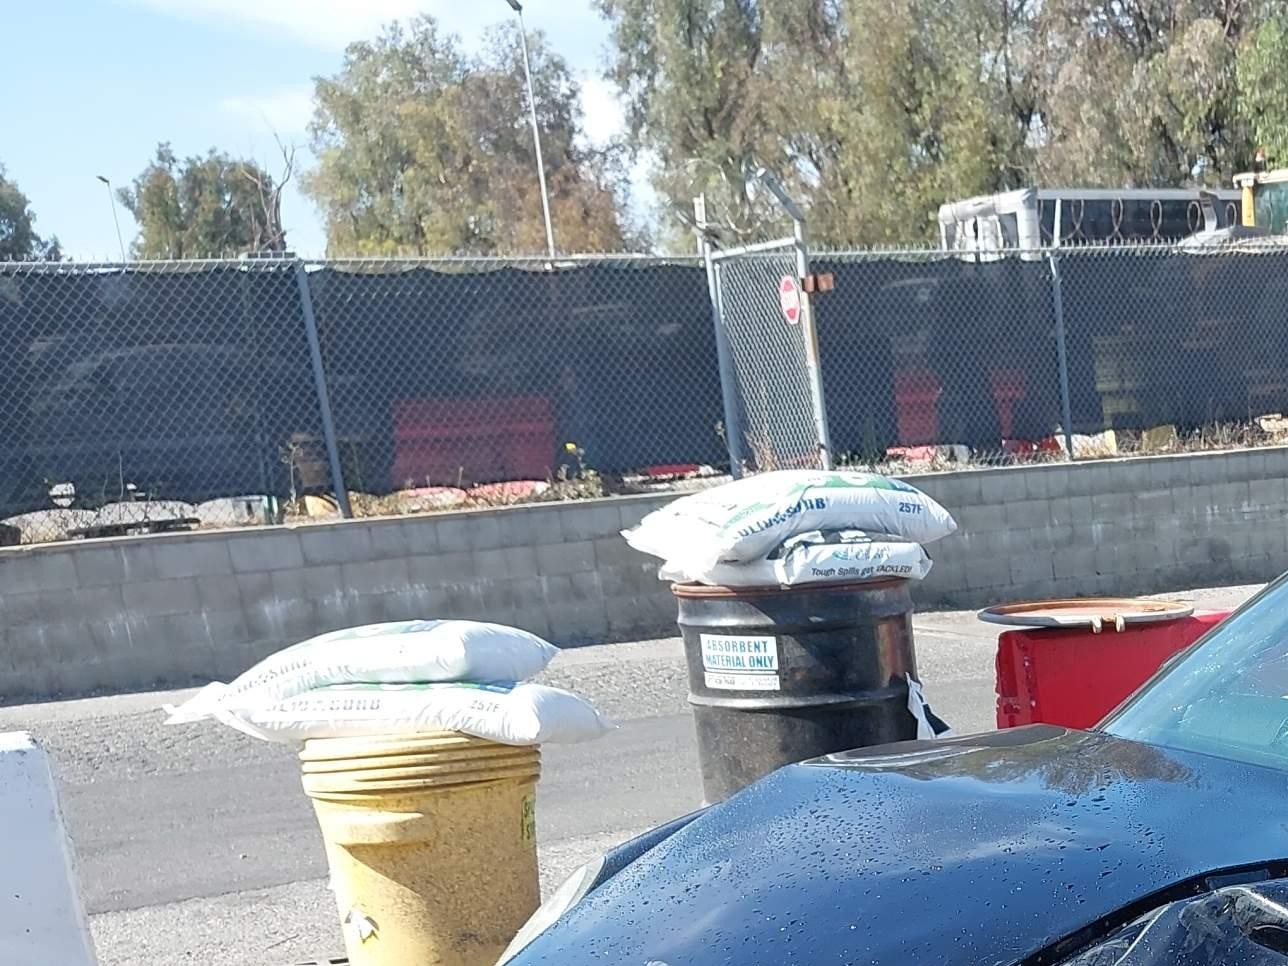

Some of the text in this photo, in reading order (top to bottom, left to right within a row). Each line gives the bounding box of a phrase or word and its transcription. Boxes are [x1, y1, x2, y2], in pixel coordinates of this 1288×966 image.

[811, 567, 836, 577] Tough
[837, 566, 860, 576] Spills
[707, 639, 768, 654] ABSORBENT
[705, 654, 774, 669] MATERIAL ONLY
